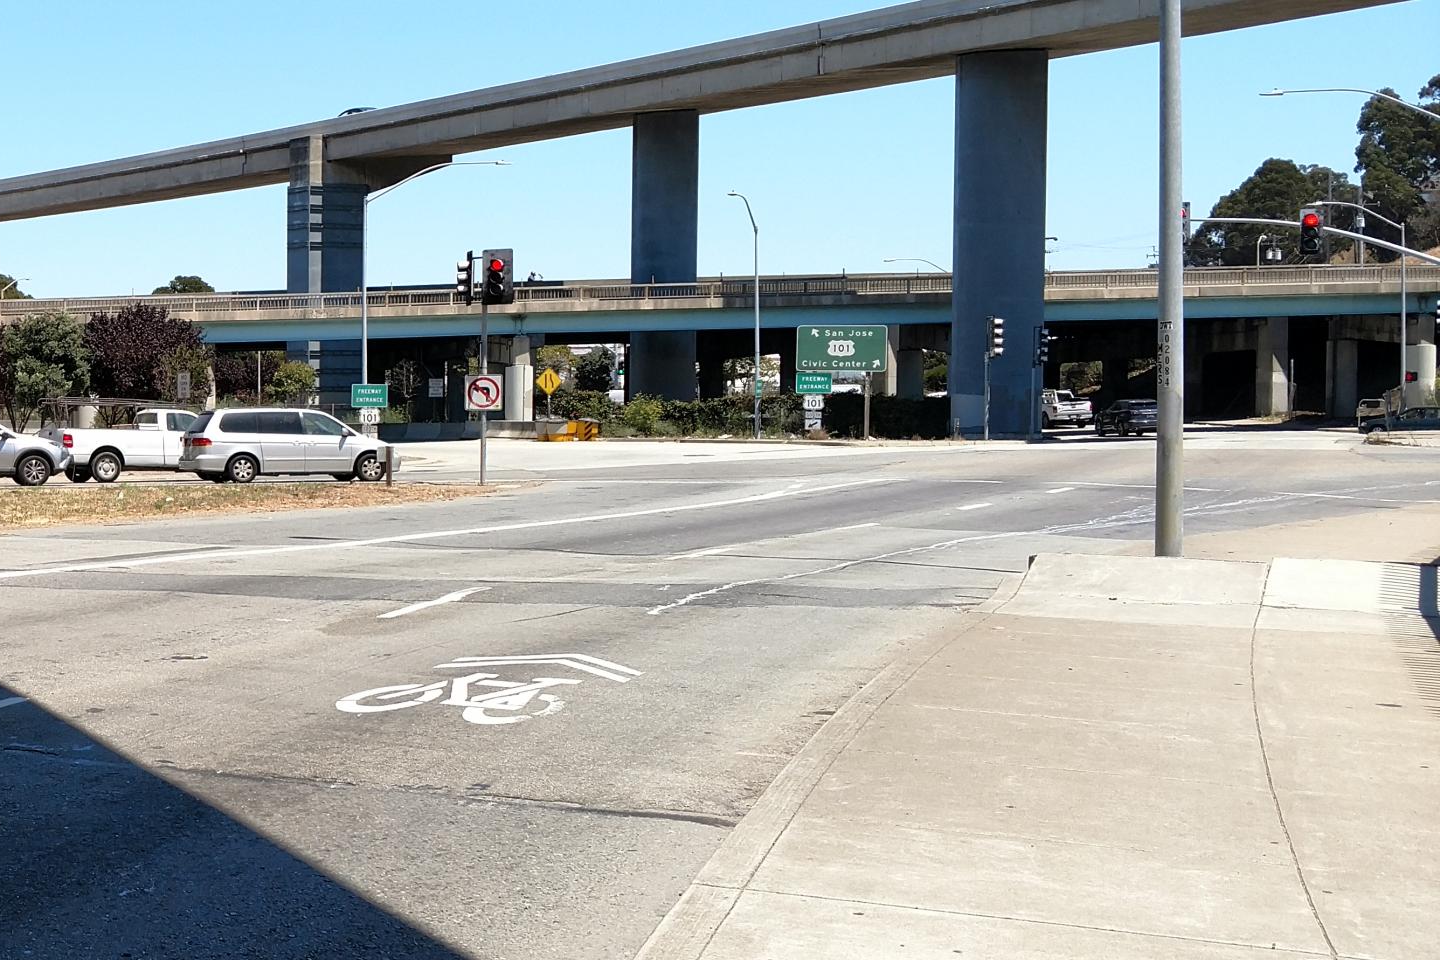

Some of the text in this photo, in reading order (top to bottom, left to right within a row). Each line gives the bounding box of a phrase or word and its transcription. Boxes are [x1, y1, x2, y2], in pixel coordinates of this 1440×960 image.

[824, 329, 873, 337] San Jose
[833, 344, 850, 352] 101
[807, 399, 821, 407] 101
[362, 413, 377, 422] 101
